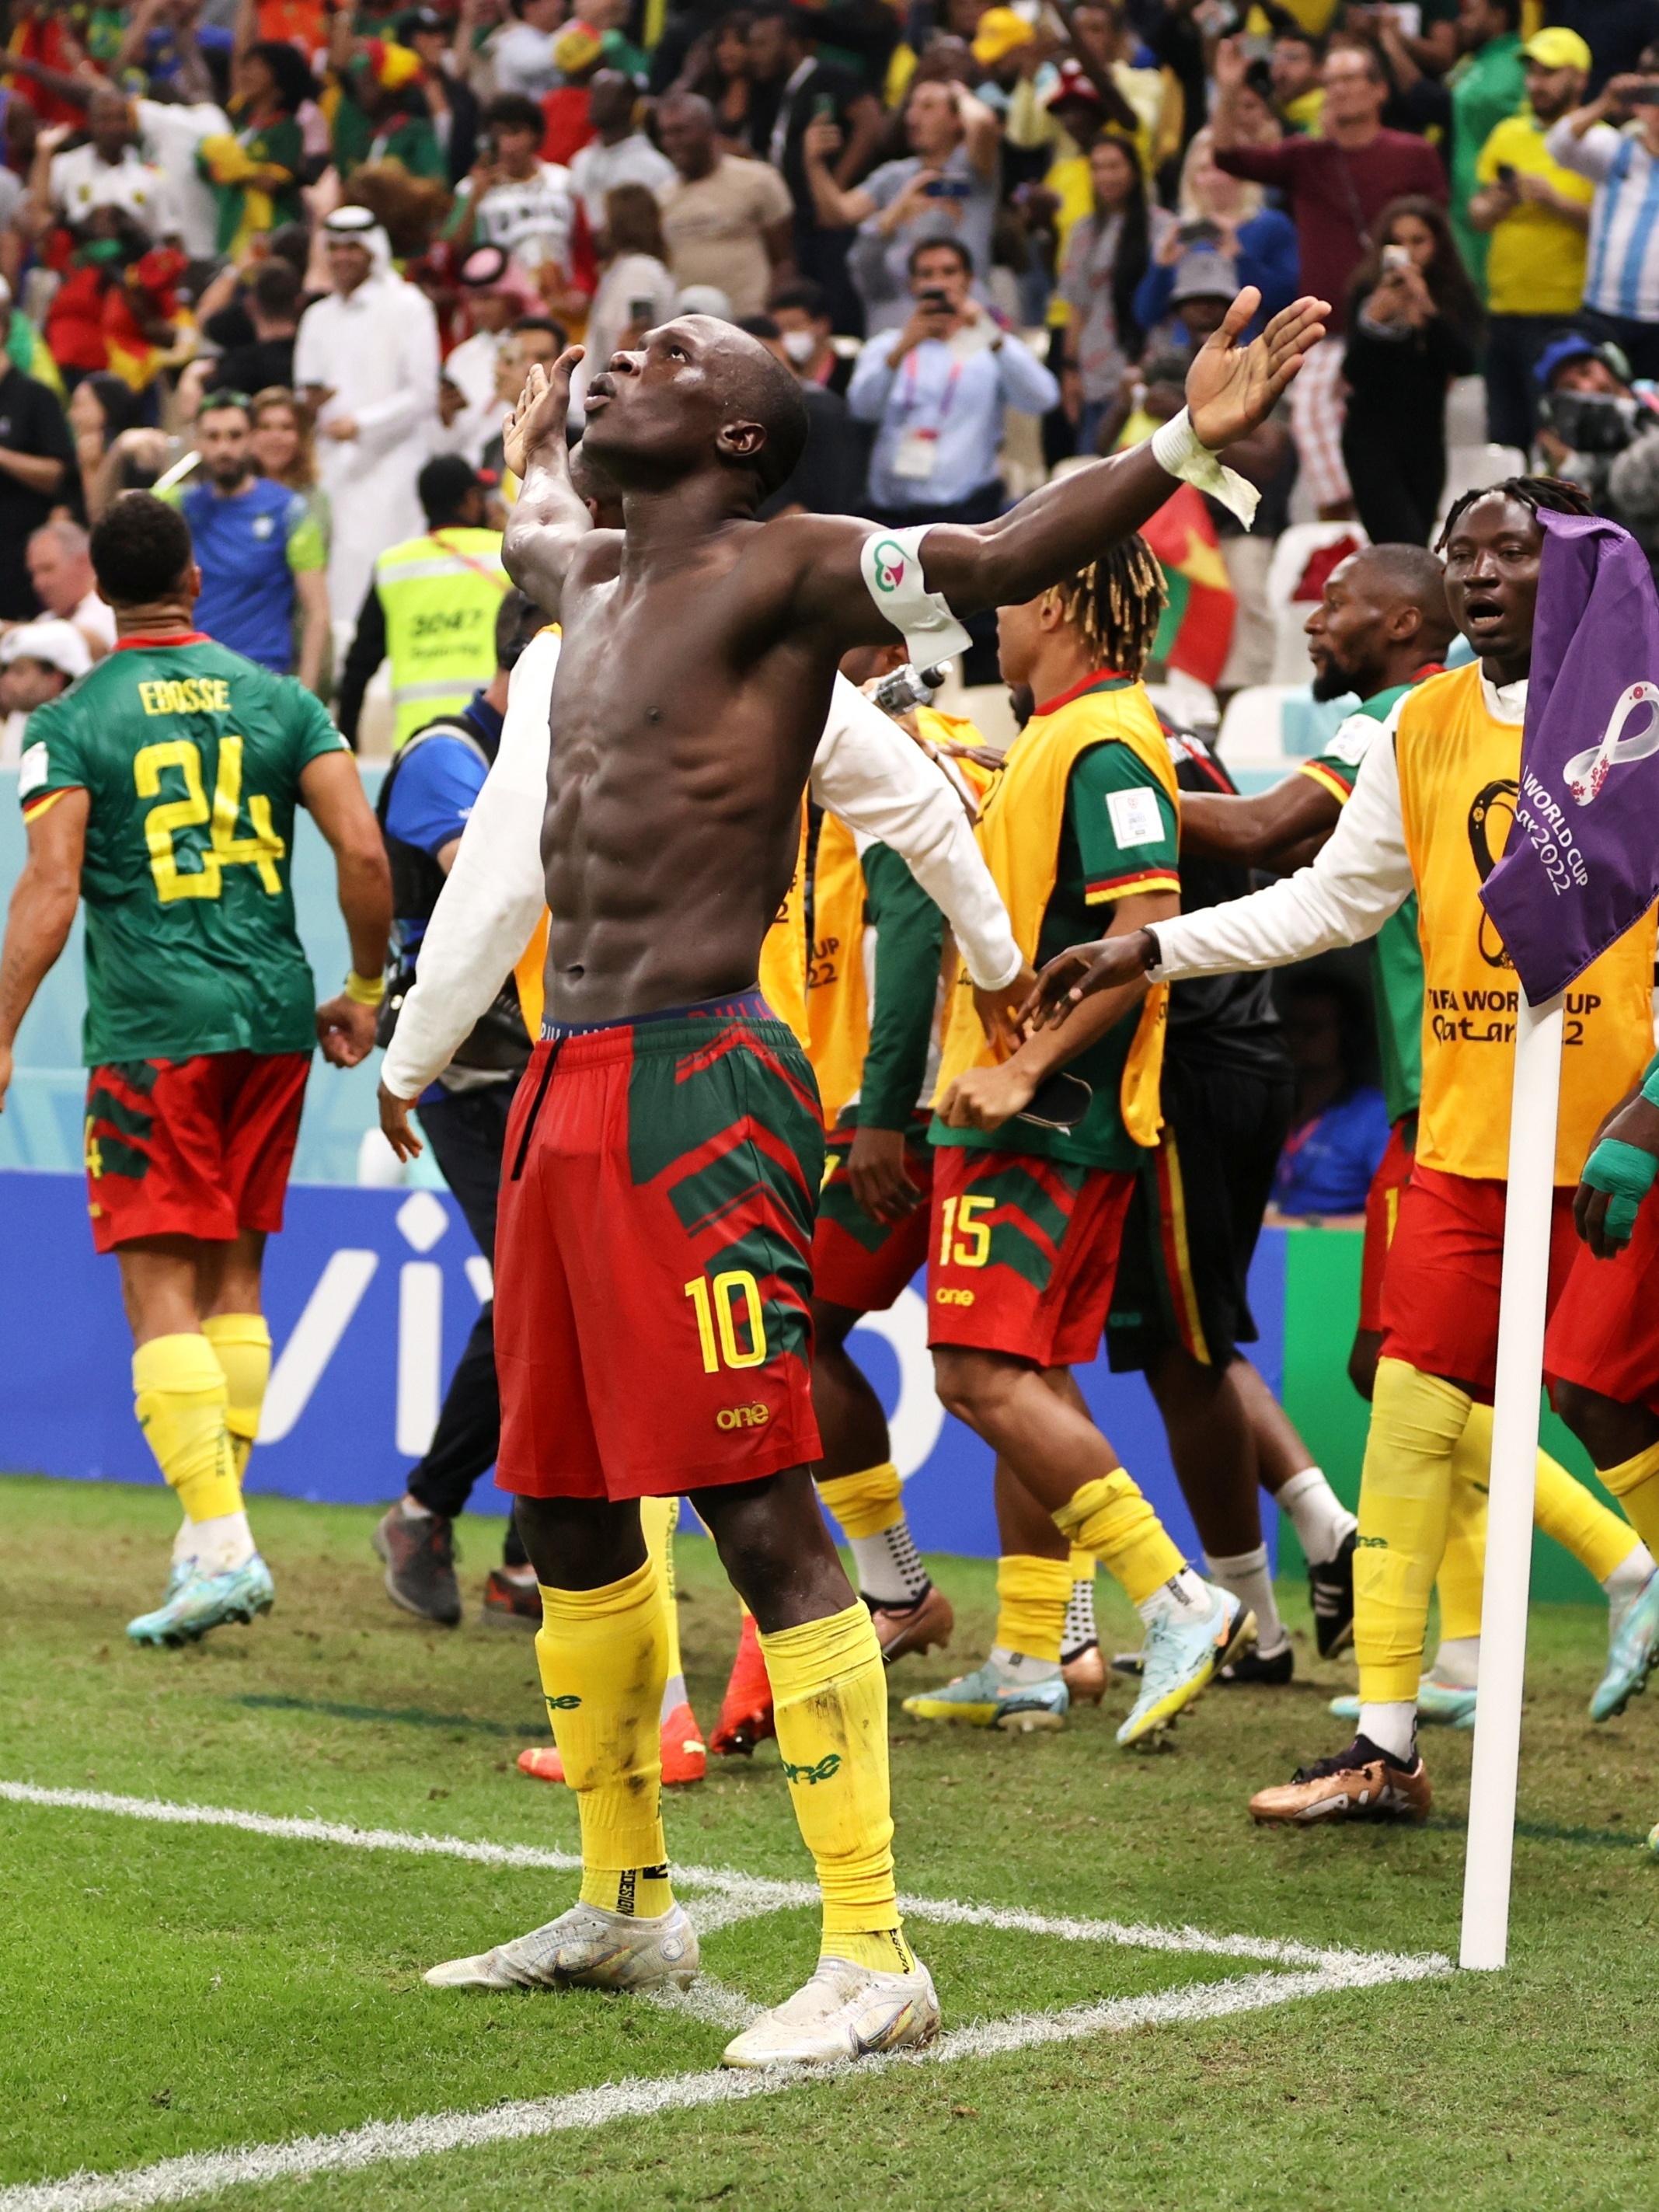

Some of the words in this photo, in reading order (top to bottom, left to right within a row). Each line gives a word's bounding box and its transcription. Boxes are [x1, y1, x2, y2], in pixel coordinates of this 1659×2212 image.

[138, 678, 232, 716] EBOSSE
[134, 735, 285, 904] 24
[1524, 773, 1572, 847] WORLD
[1567, 848, 1588, 886] CUP
[814, 937, 839, 959] UP
[1463, 991, 1518, 1012] WOR
[1563, 993, 1601, 1014] UP
[939, 1195, 996, 1267] 15
[936, 1287, 975, 1307] one
[685, 1270, 767, 1373] 10
[716, 1403, 769, 1429] one
[1355, 1535, 1388, 1549] ne
[545, 1695, 582, 1710] ne
